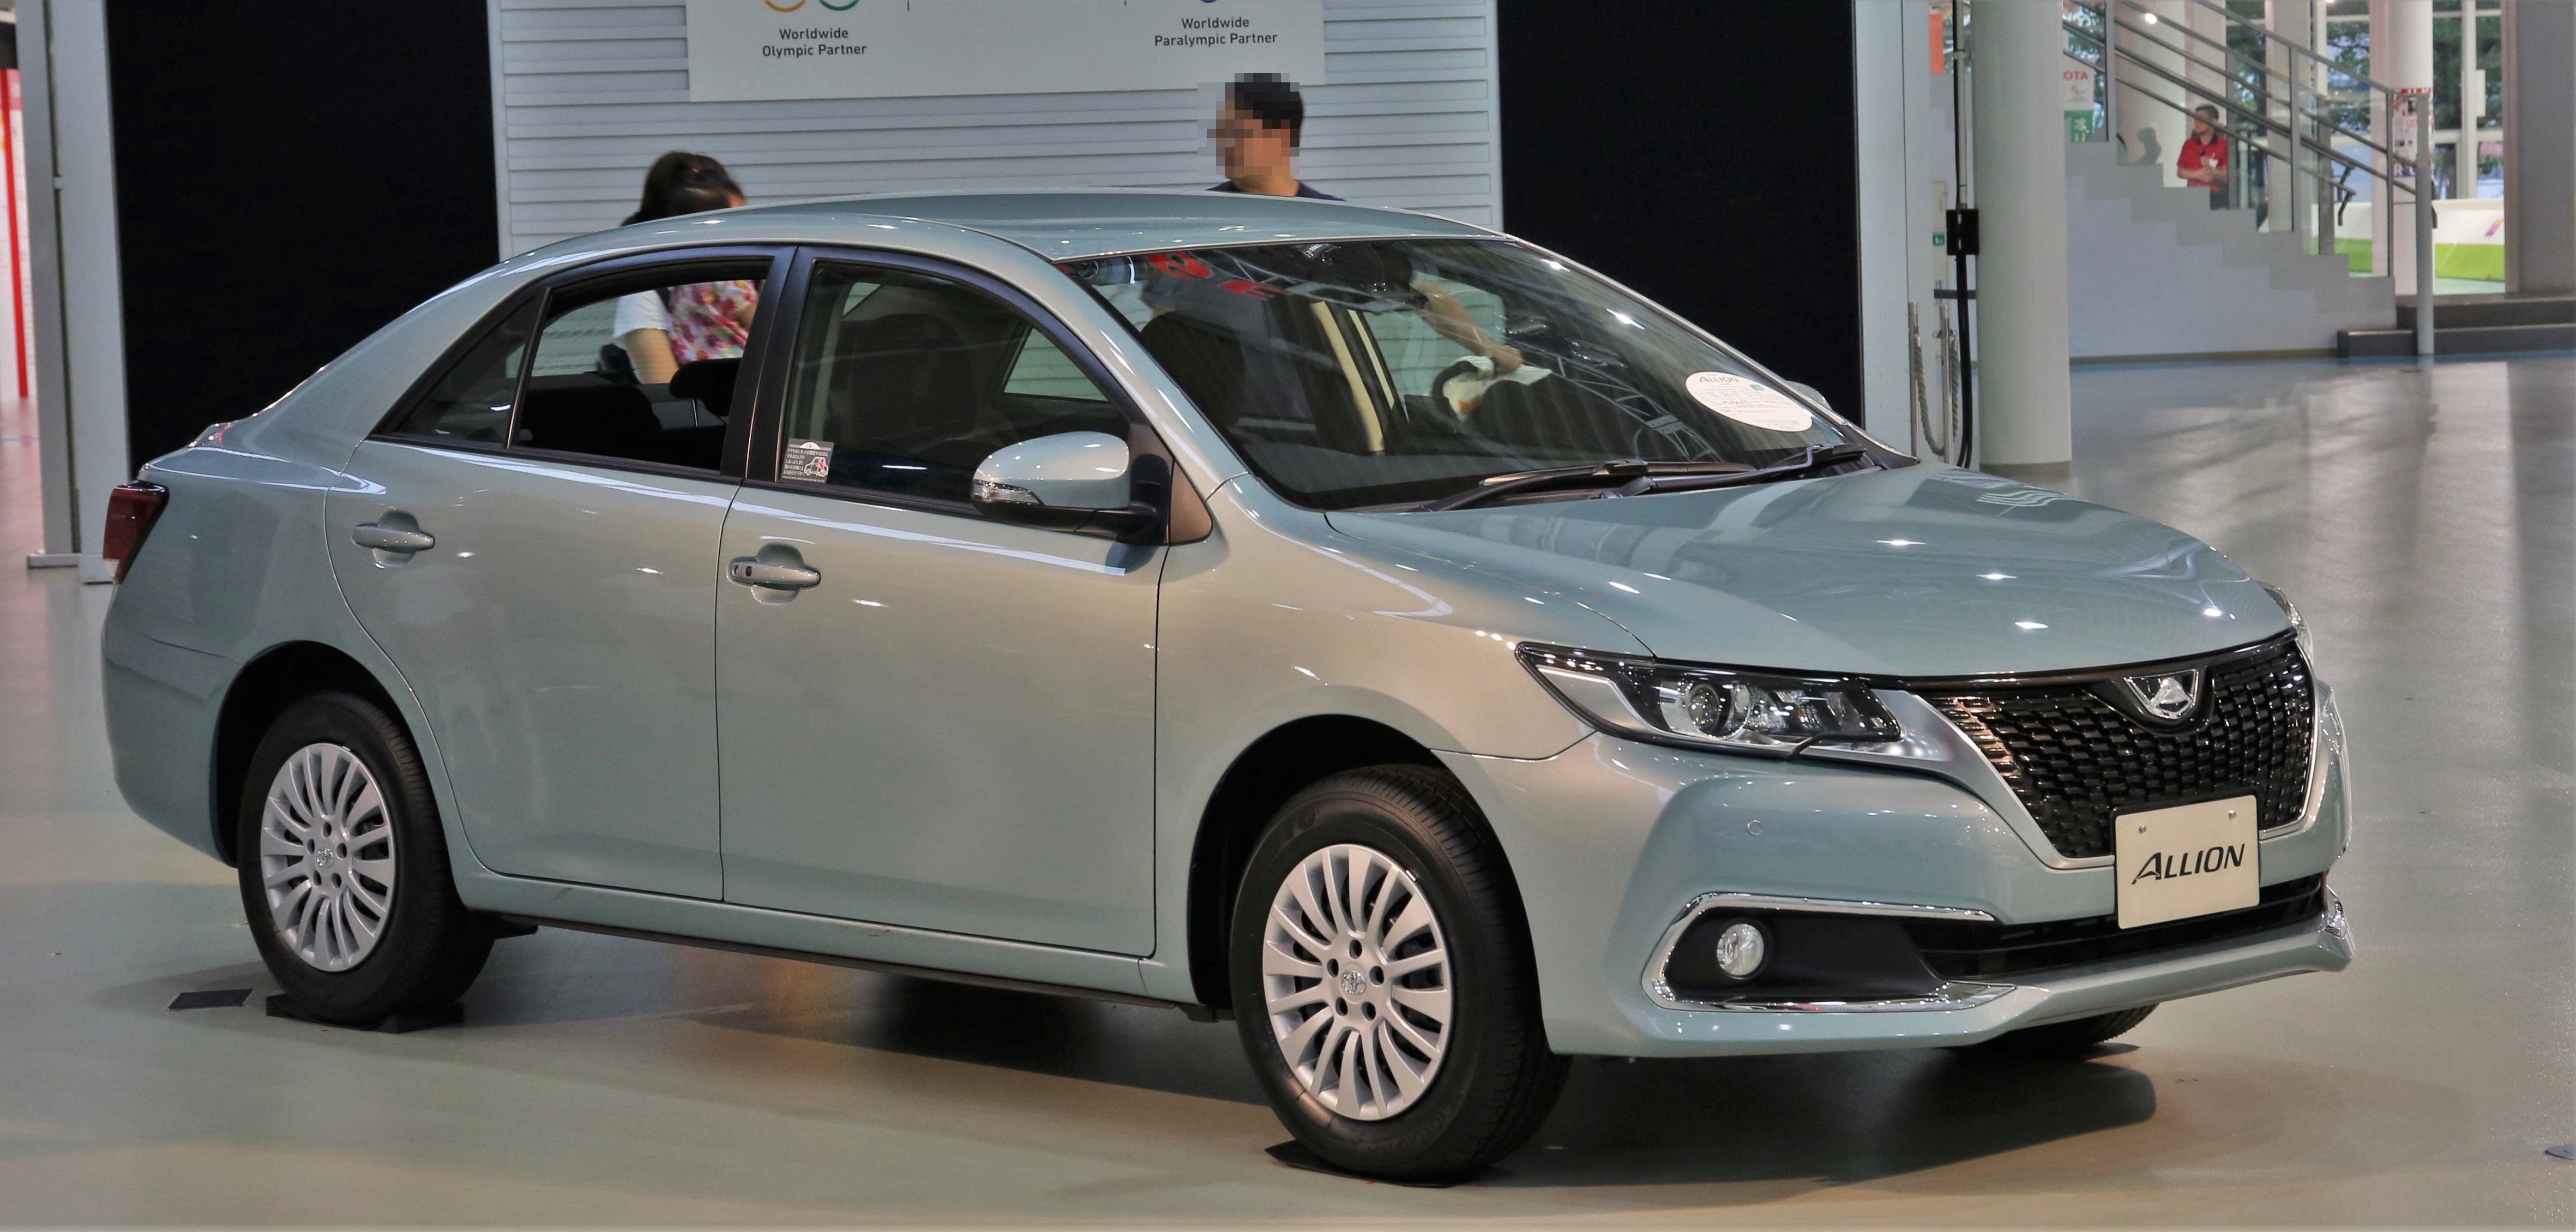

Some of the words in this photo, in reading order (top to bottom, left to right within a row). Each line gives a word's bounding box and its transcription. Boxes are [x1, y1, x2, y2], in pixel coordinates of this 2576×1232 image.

[1182, 16, 1250, 29] Worldwide
[779, 27, 849, 40] Worldwide
[1155, 33, 1226, 47] Paralympic
[1230, 33, 1278, 44] Partner
[762, 44, 814, 59] Olympic
[818, 44, 868, 55] Partner
[2063, 70, 2089, 80] OTA
[2131, 843, 2246, 885] ALLION
